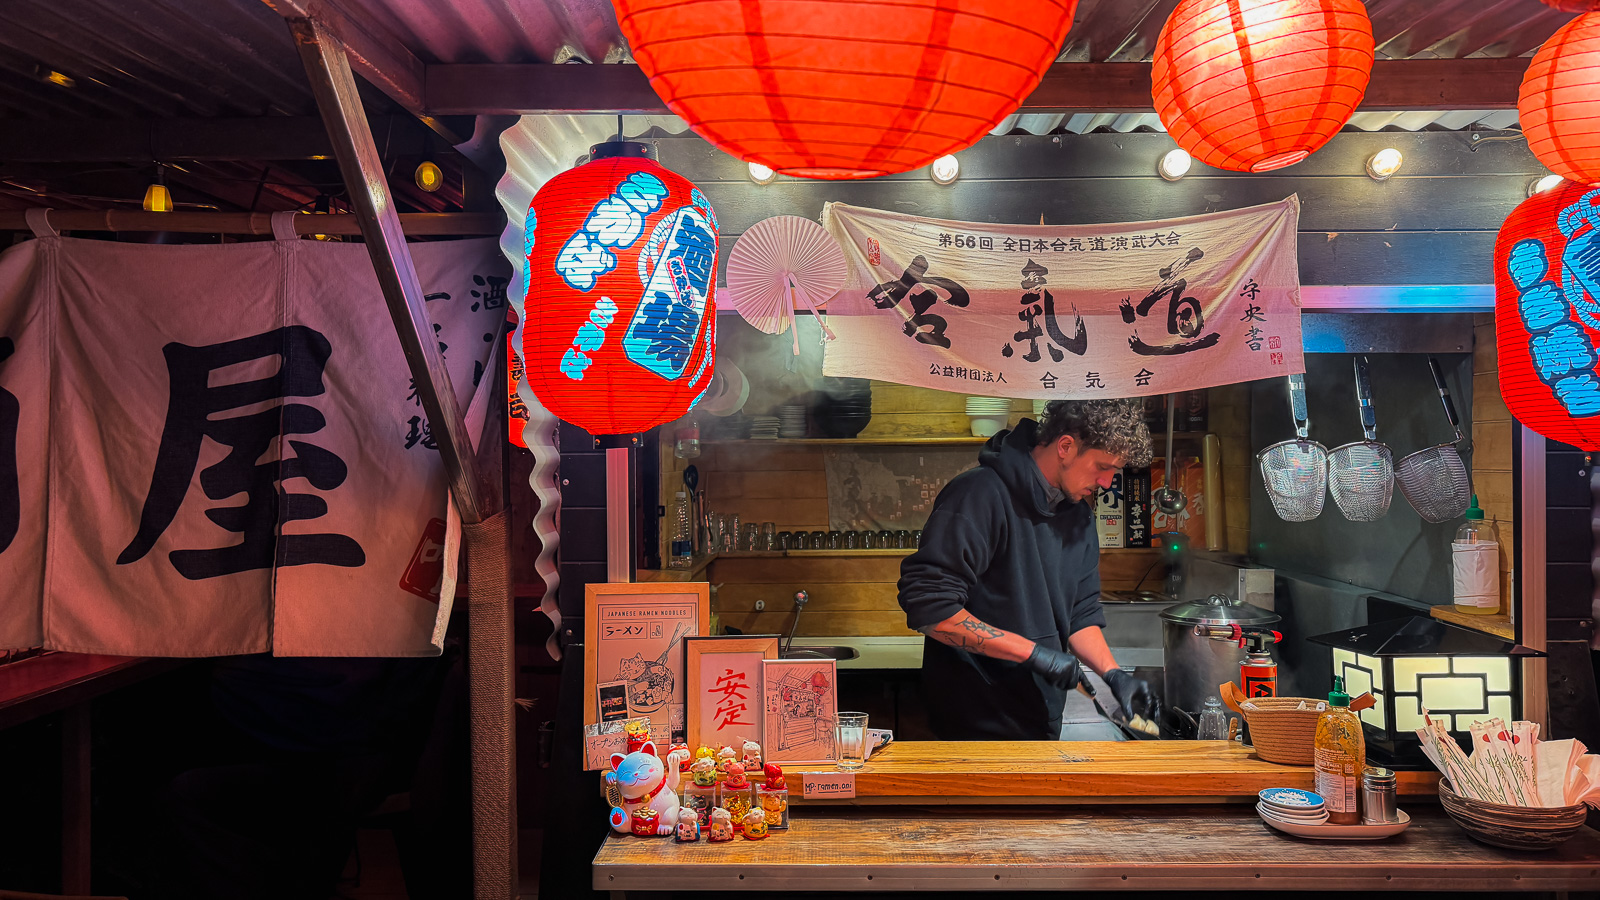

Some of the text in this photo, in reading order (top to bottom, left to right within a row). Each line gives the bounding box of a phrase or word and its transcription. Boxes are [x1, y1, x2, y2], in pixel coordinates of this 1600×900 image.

[938, 230, 1182, 254] 第56回 全日本合気道演武大会
[1239, 278, 1267, 351] 守央書
[929, 362, 1155, 389] 公益財団法人 合気会
[0, 324, 366, 581] 屋
[605, 625, 644, 637] ラーメン
[707, 668, 756, 732] 安定
